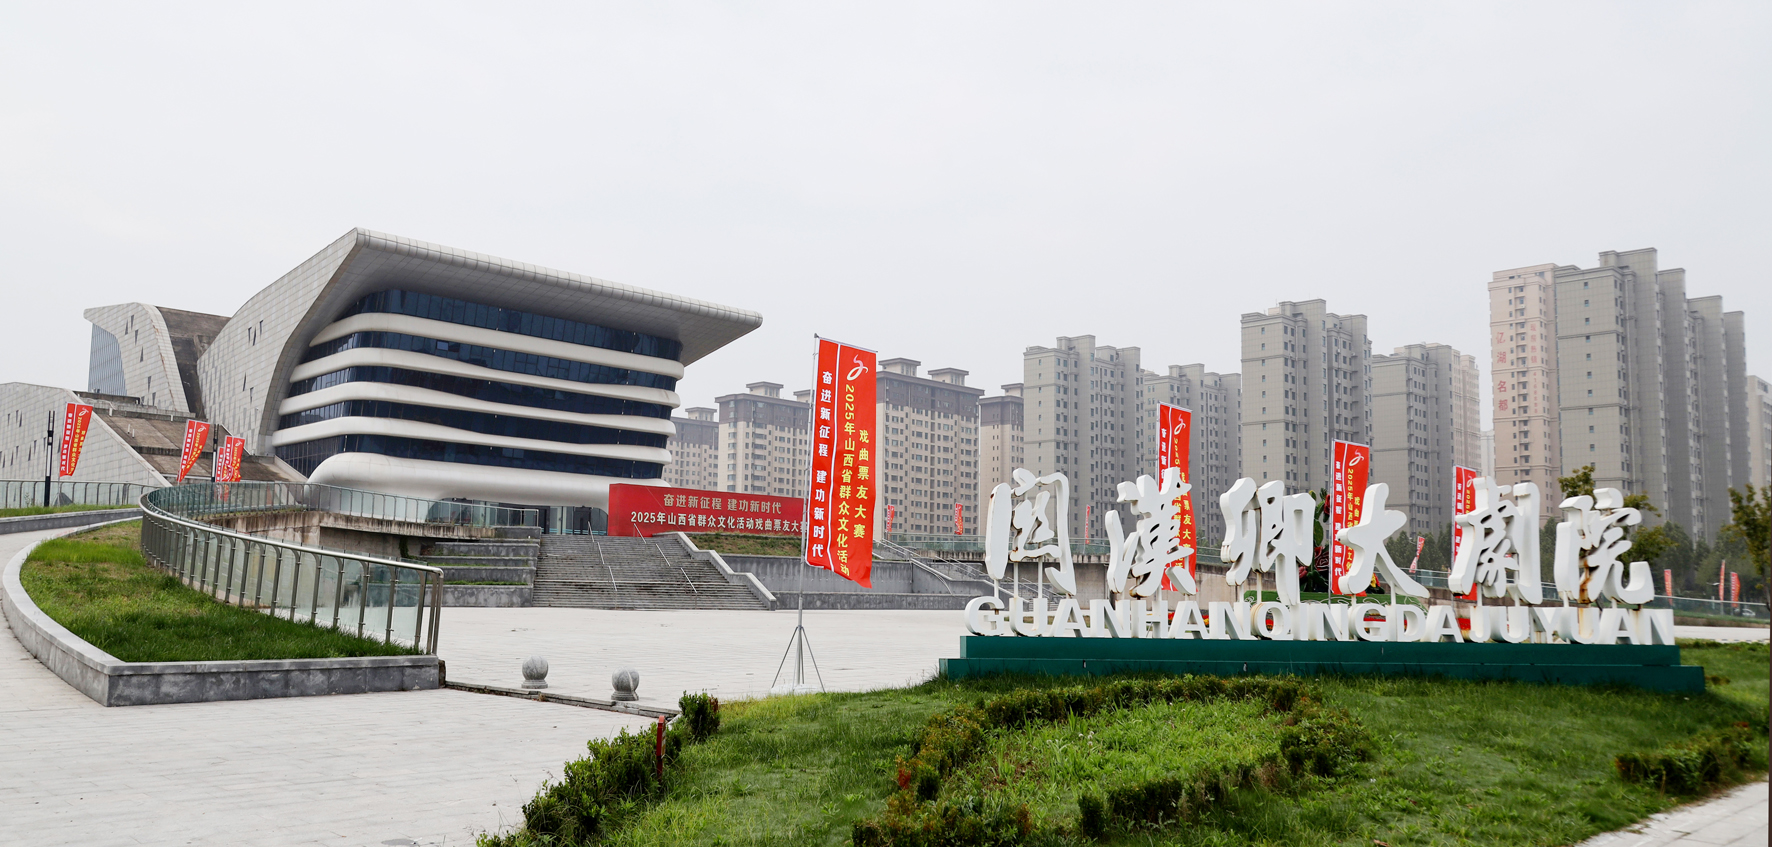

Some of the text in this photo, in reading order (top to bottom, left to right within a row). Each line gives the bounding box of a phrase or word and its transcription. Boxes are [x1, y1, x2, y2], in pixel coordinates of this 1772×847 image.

[1496, 332, 1509, 411] 亿湖名都
[663, 494, 782, 514] 奋进新征程 建功新时代
[812, 371, 833, 558] 奋进新征程 建功新时代
[836, 384, 856, 577] 2025年山西省群众文化活动
[853, 429, 870, 539] 戏曲票友大赛
